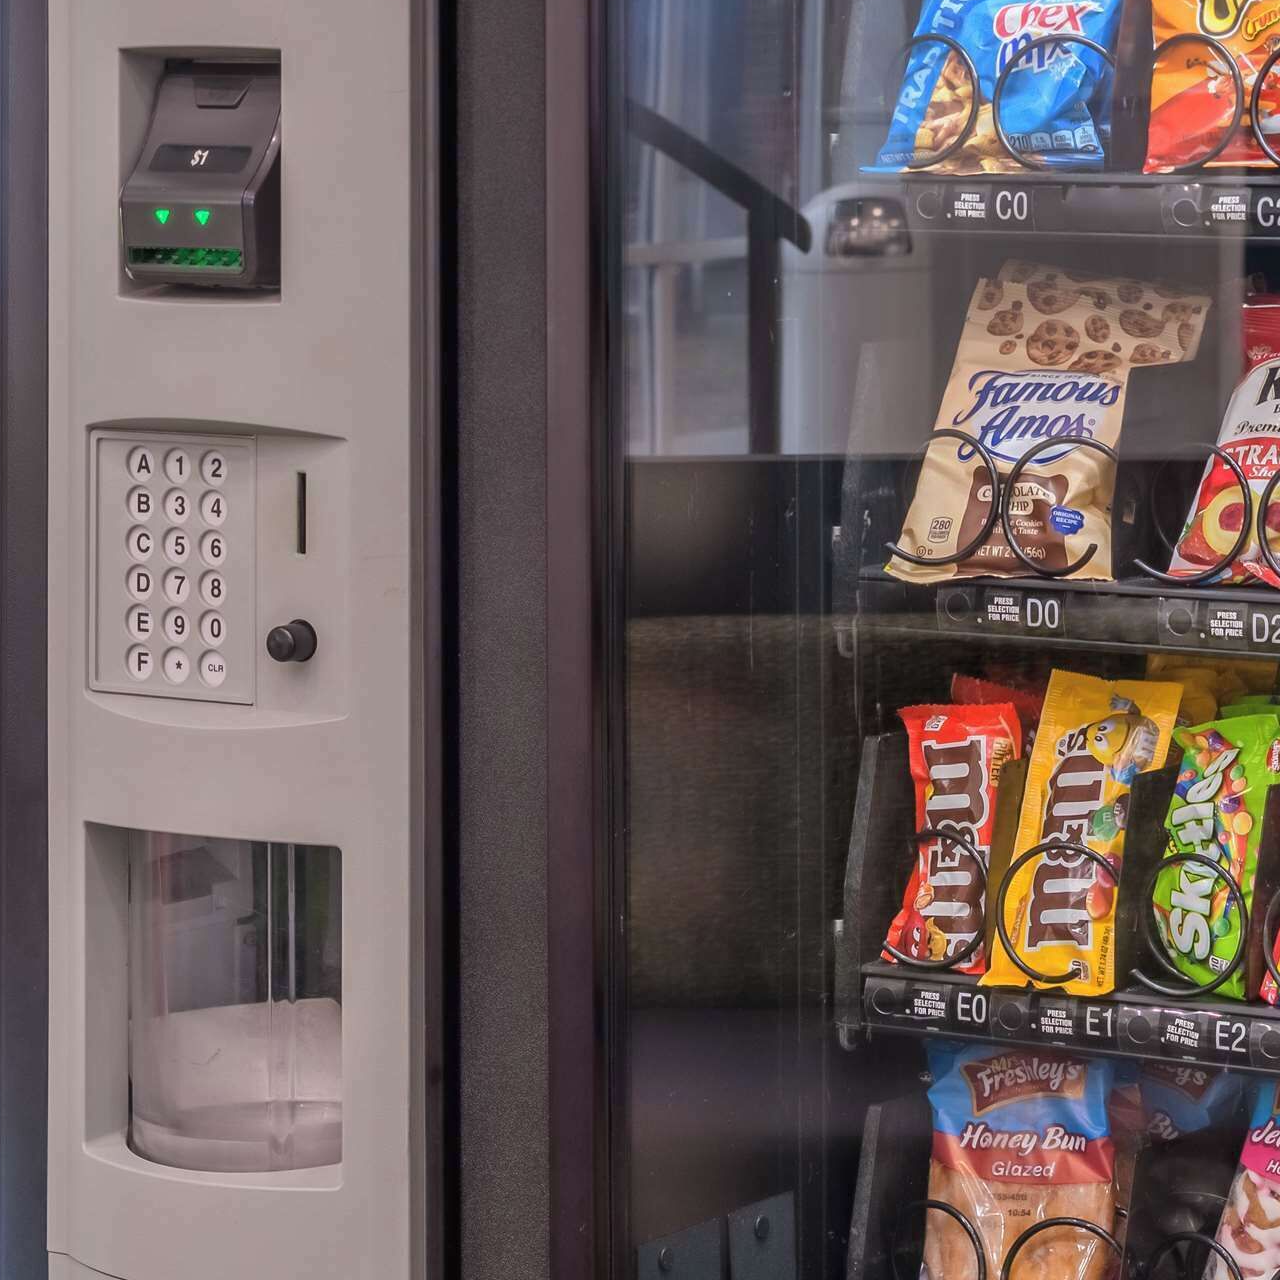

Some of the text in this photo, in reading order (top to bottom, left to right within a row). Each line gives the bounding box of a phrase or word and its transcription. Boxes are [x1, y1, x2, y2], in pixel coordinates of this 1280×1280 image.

[995, 1, 1089, 38] Chex
[996, 191, 1028, 220] C0
[953, 371, 1121, 426] Famous
[958, 406, 1094, 458] Amos
[138, 454, 151, 473] A
[176, 456, 183, 475] 1
[211, 458, 221, 477] 2
[138, 494, 150, 513] B
[175, 496, 185, 515] 3
[211, 498, 221, 517] 4
[932, 520, 951, 530] 280
[137, 534, 150, 553] C
[175, 536, 184, 555] 5
[211, 539, 220, 557] 6
[137, 573, 150, 592] D
[175, 576, 185, 594] 7
[211, 579, 221, 597] 8
[138, 613, 149, 632] E
[1027, 599, 1059, 628] D0
[175, 616, 184, 634] 9
[138, 653, 149, 671] F
[208, 664, 223, 672] CLR
[958, 993, 986, 1022] E0
[1086, 1007, 1113, 1037] E1
[1216, 1022, 1247, 1052] E2
[977, 1057, 1081, 1098] Freshley's
[960, 1124, 1087, 1156] Honey Bun
[991, 1161, 1056, 1179] Glazed
